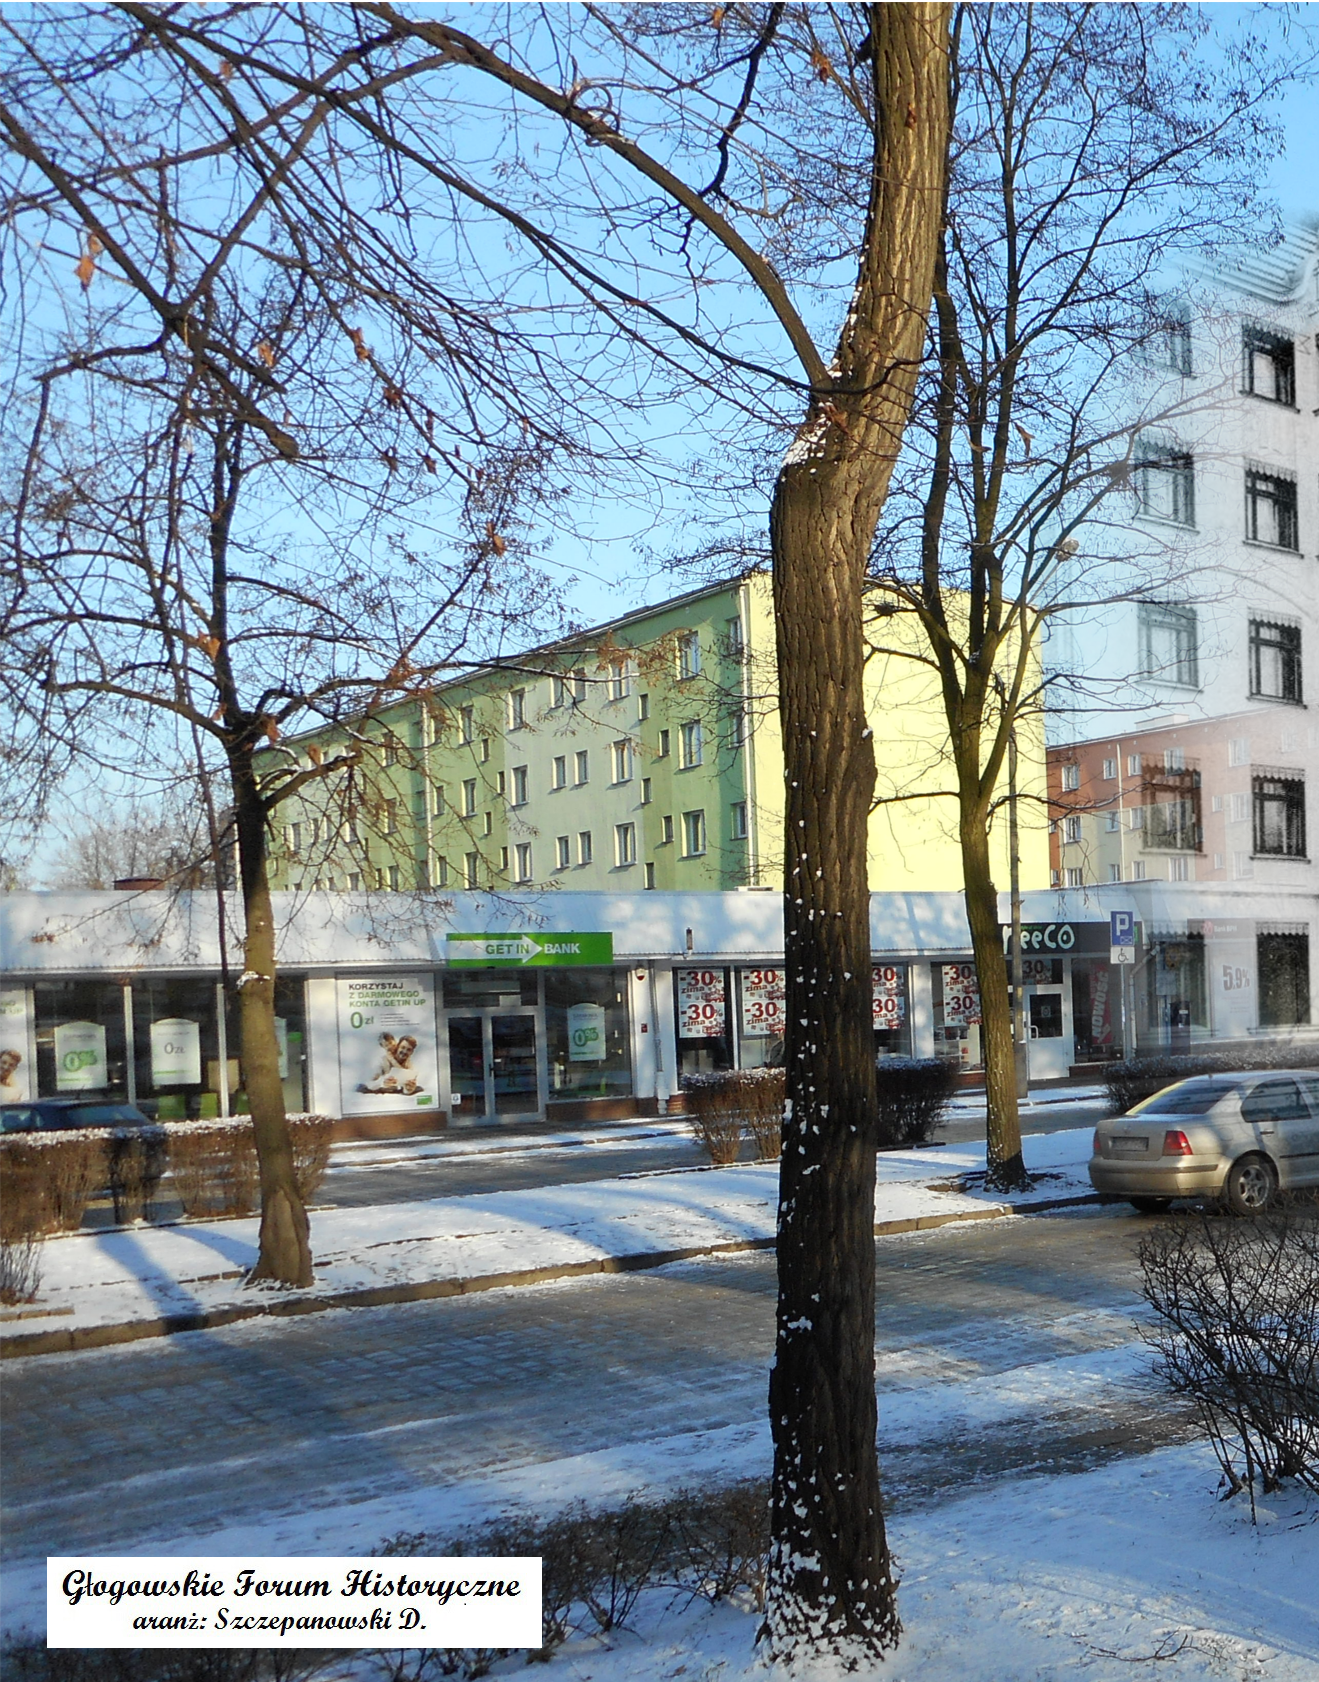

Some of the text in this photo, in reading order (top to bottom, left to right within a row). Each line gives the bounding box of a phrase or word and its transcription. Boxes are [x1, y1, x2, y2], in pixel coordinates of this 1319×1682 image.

[1116, 914, 1129, 936] P
[544, 943, 581, 954] BANK
[680, 970, 722, 987] -30%
[348, 982, 404, 991] KORZYSTAJ
[358, 990, 420, 999] DARMOWEGO
[349, 1000, 380, 1008] KONTA
[681, 1003, 723, 1020] -30%
